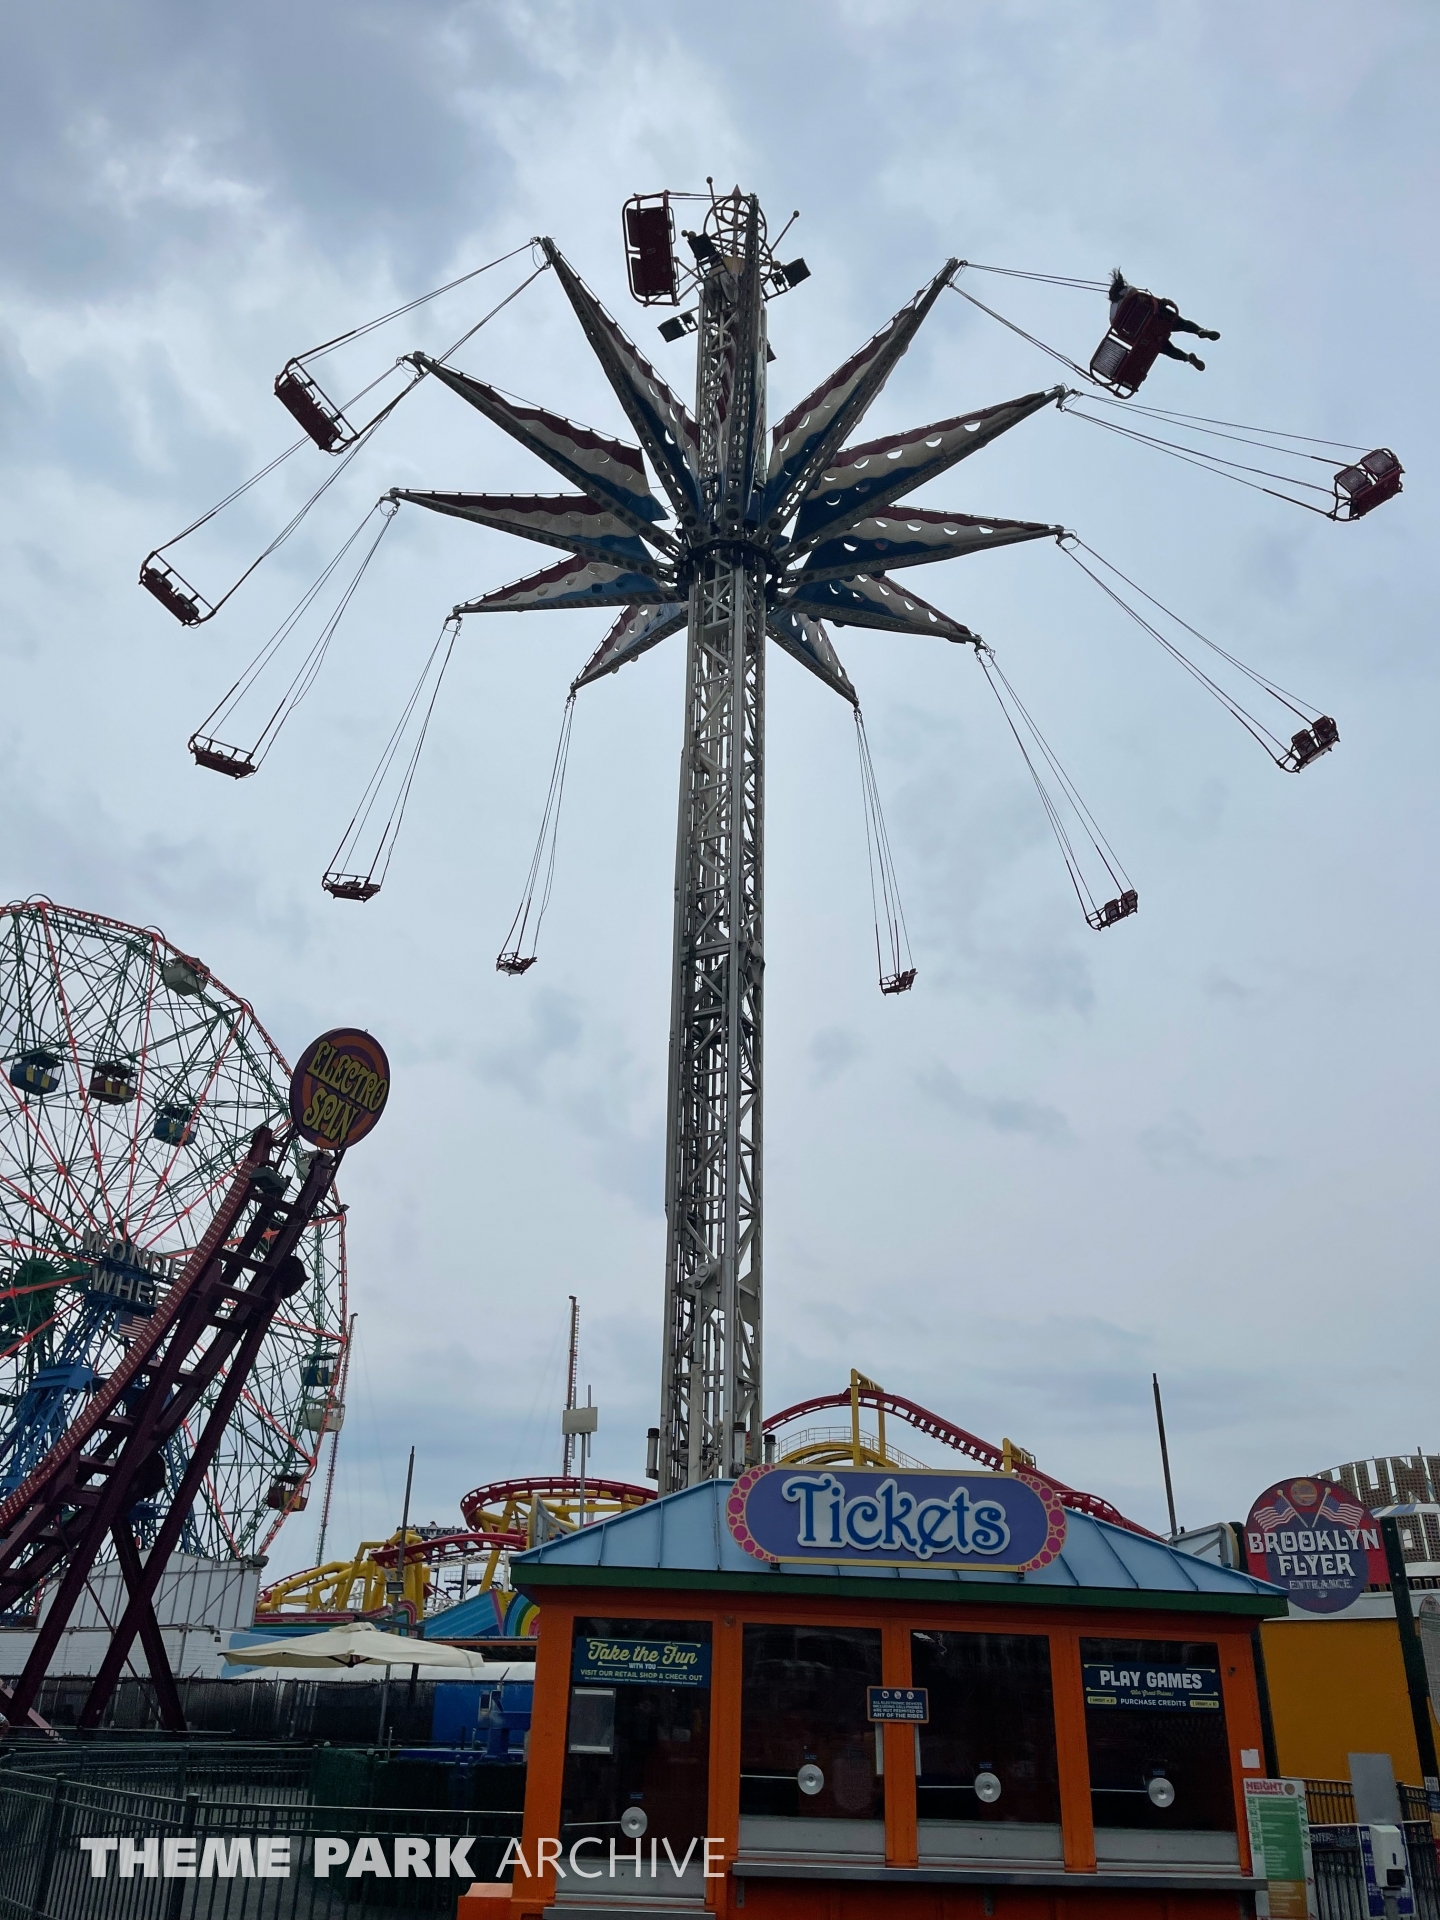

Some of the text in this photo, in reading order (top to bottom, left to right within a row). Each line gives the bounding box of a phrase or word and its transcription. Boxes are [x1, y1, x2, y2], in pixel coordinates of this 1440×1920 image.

[307, 1041, 388, 1111] ELECTRO
[302, 1087, 359, 1145] SPIN
[82, 1228, 187, 1279] WONDE
[92, 1266, 171, 1307] WHEE
[784, 1475, 1008, 1557] Tickets
[1248, 1528, 1380, 1554] BROOKLYN
[1278, 1554, 1356, 1577] FLYER
[1289, 1579, 1354, 1590] ENTRANCE
[588, 1641, 698, 1665] Take the Fun
[628, 1662, 643, 1670] WITH
[639, 1671, 658, 1679] SHOP
[1100, 1670, 1203, 1689] PLAY GAMES
[1120, 1698, 1186, 1707] PURCHASE CREDITS
